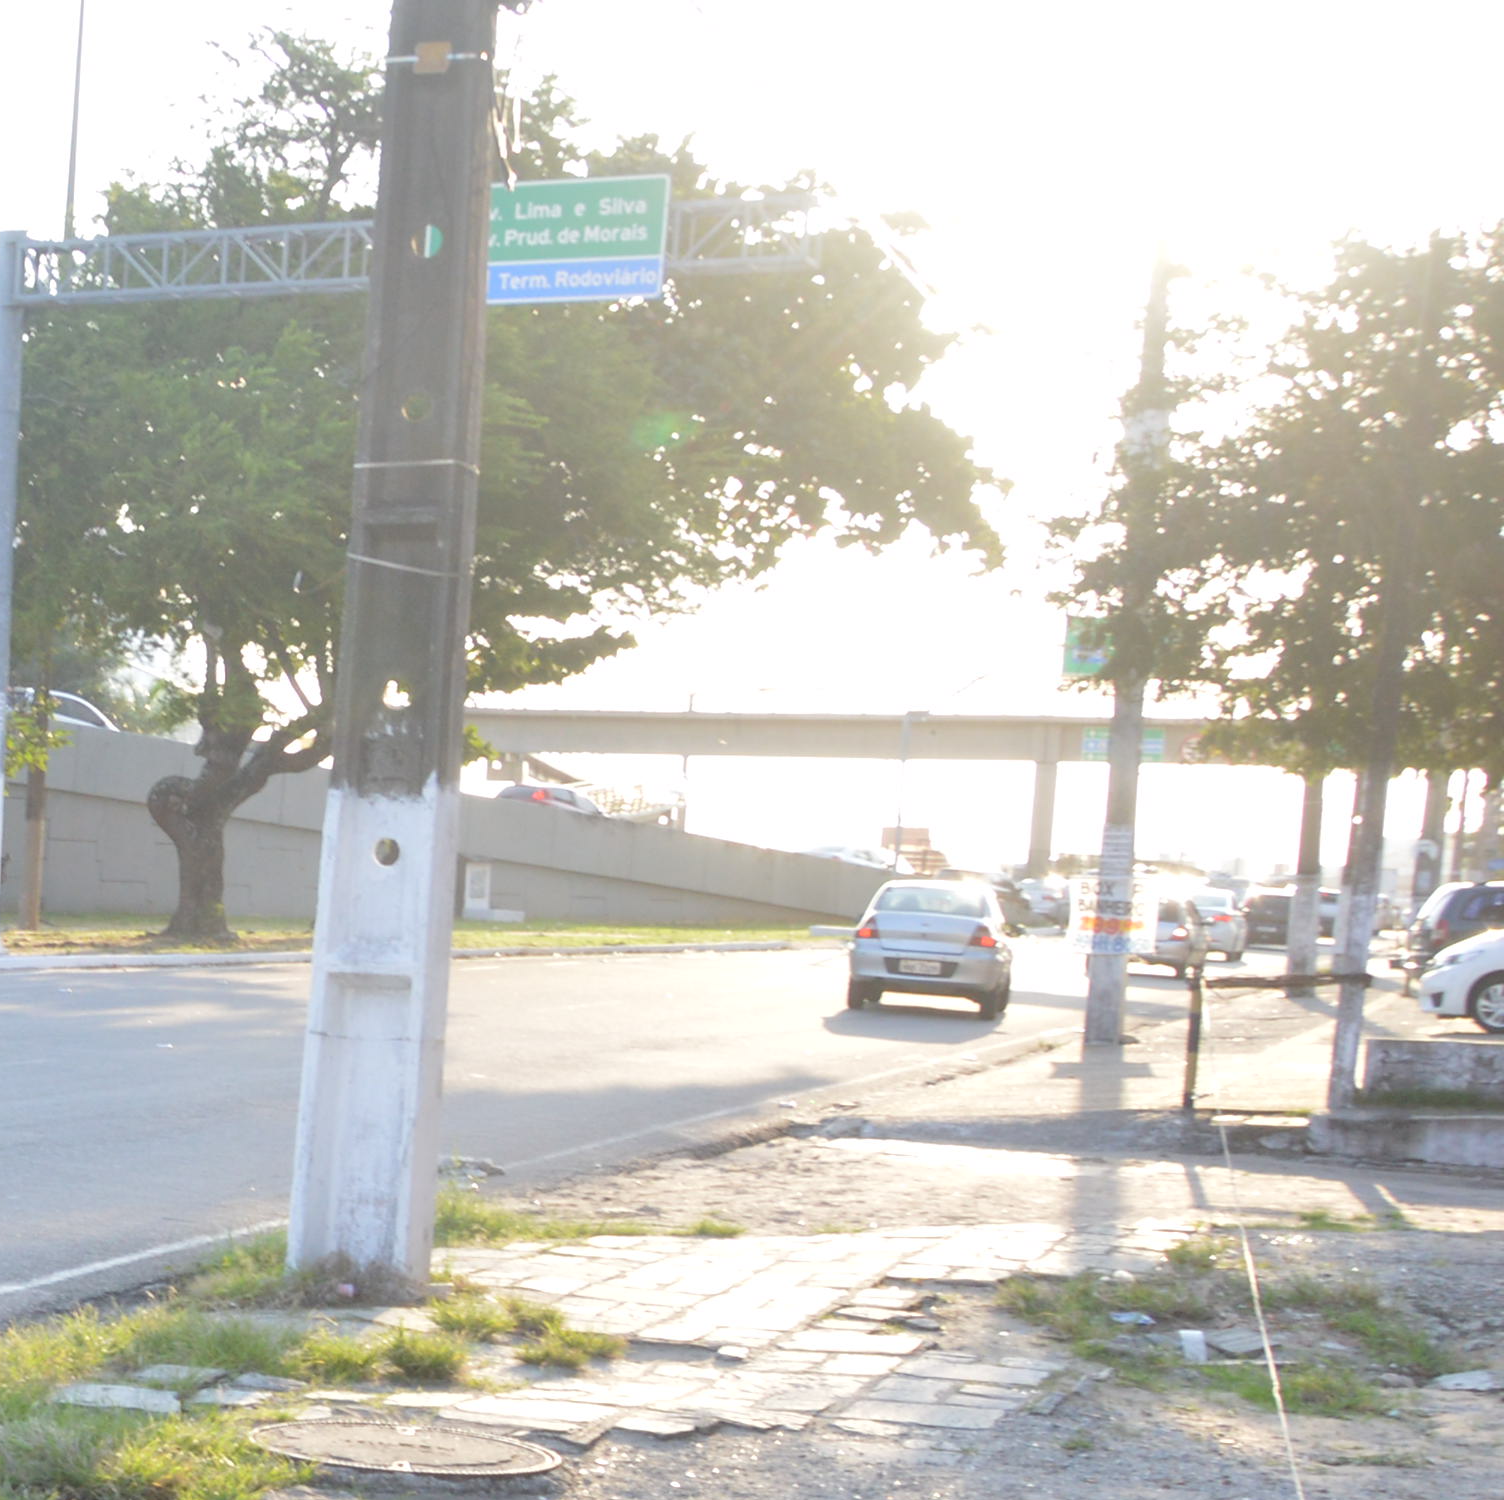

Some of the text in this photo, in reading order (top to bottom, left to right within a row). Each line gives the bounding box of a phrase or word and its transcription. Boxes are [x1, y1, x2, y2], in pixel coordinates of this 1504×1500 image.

[488, 197, 647, 221] v. Lima e Silva
[504, 228, 553, 247] Prud.
[557, 226, 581, 244] de
[584, 224, 648, 242] Morais
[499, 267, 657, 290] Term. Rodoviário
